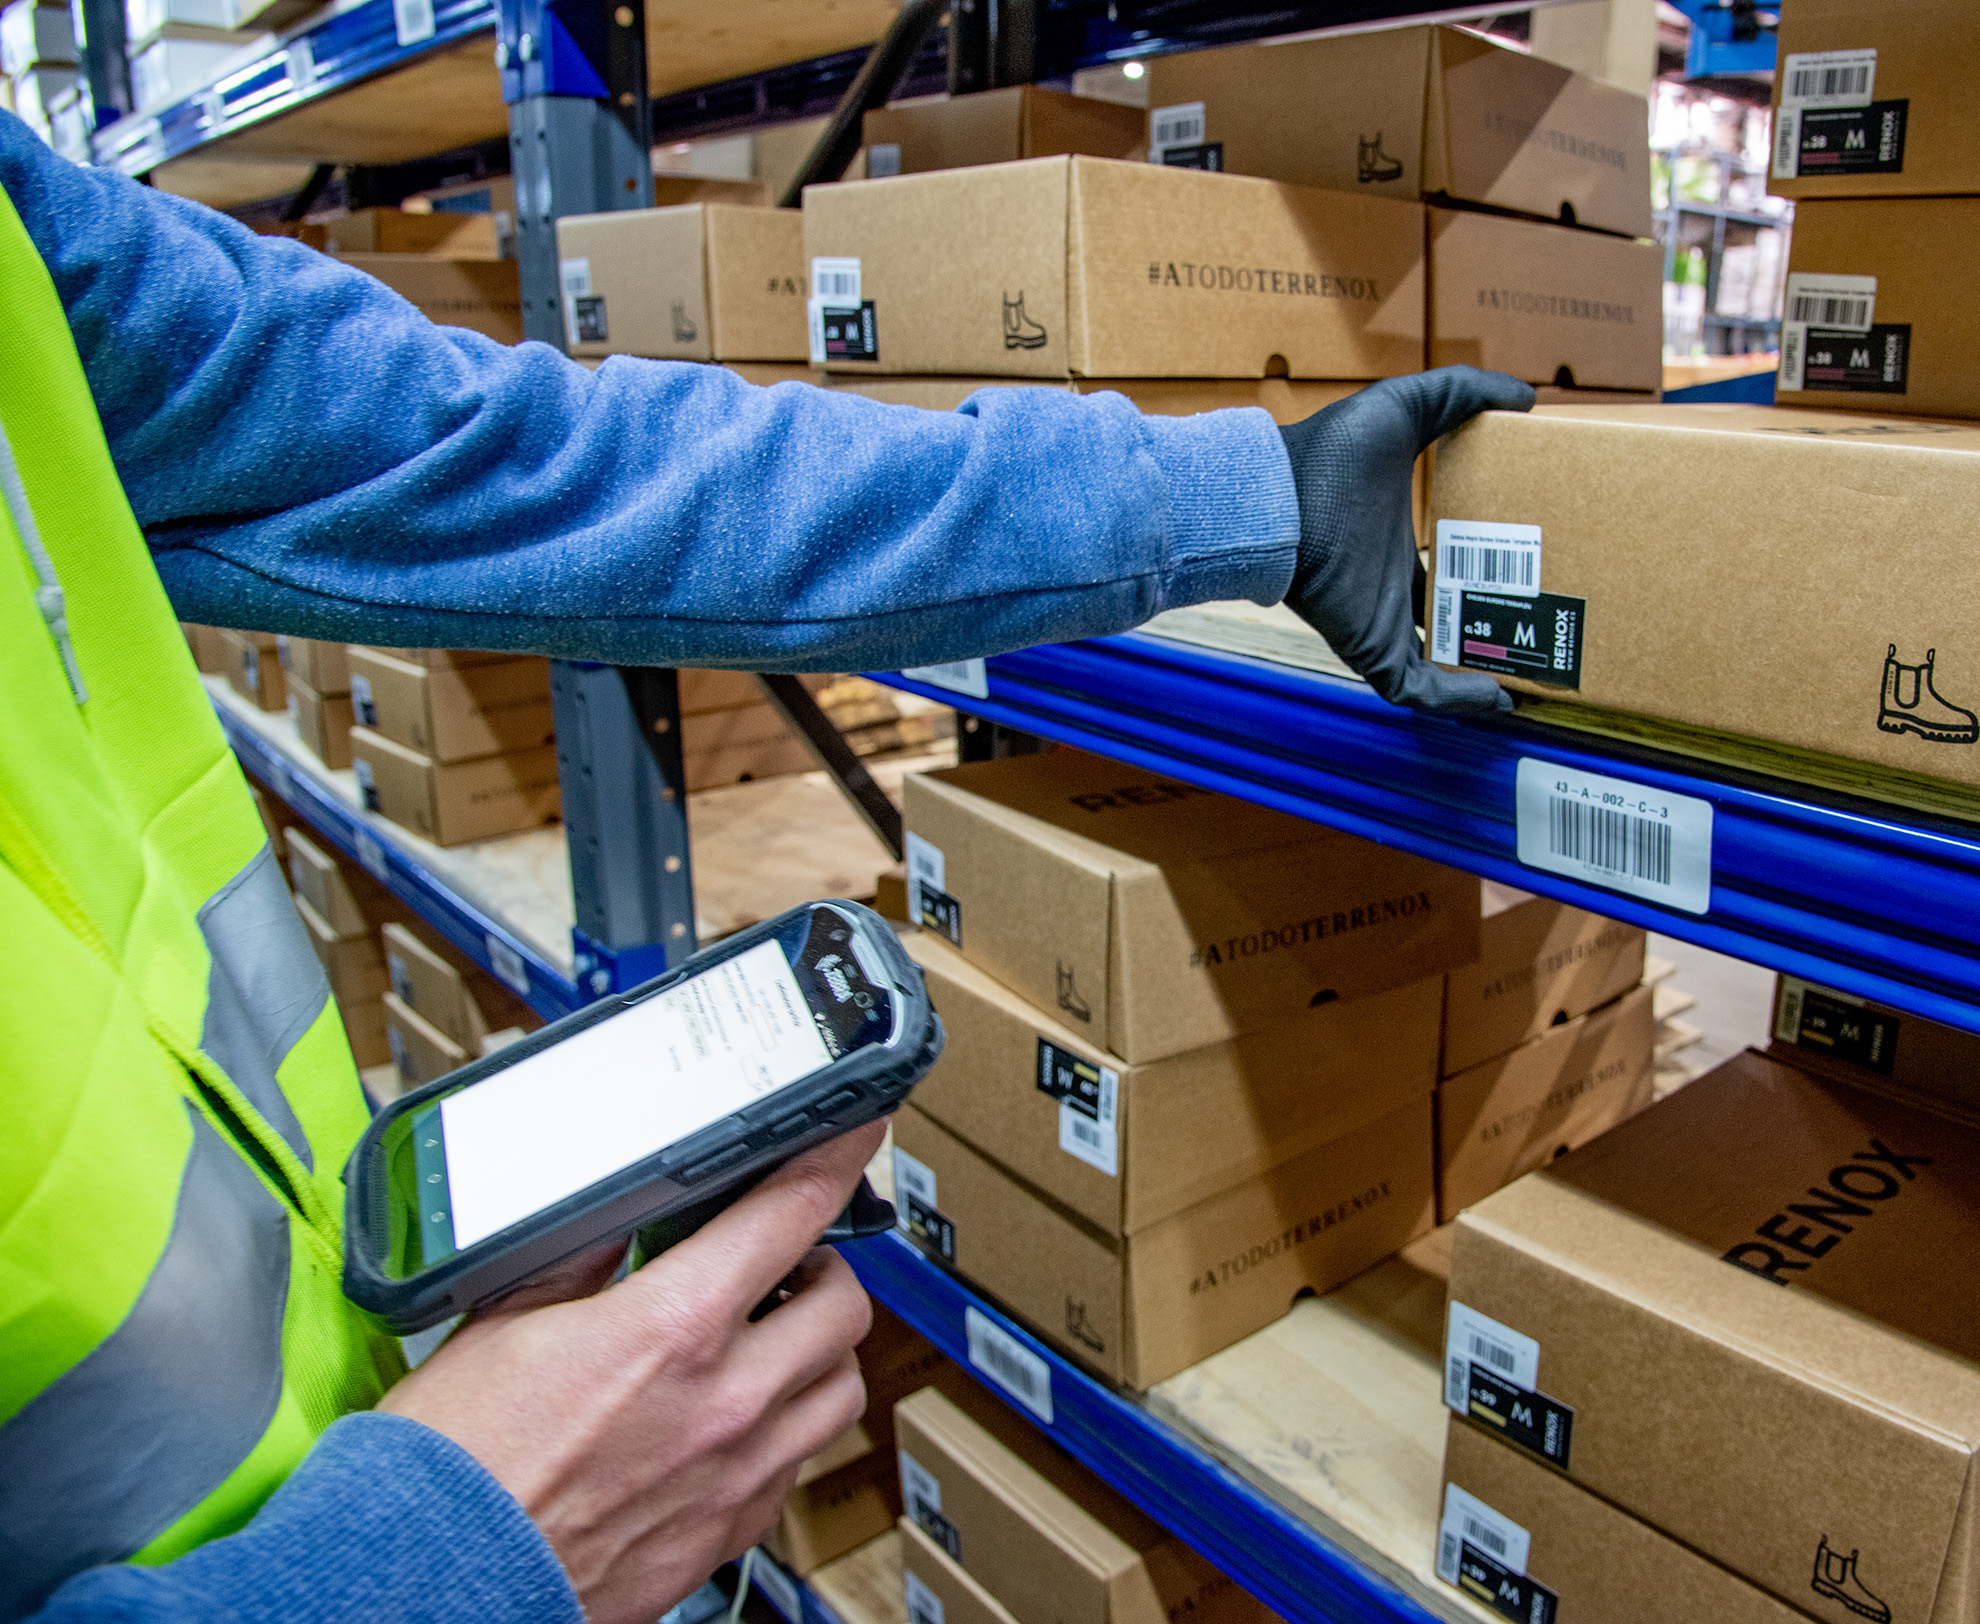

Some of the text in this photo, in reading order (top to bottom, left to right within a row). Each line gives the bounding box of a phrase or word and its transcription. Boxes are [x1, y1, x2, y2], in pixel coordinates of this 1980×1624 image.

[1845, 128, 1866, 149] M
[1148, 261, 1382, 301] #ATODOTERRENOX
[1850, 348, 1870, 368] M
[1473, 620, 1492, 637] 38
[1513, 621, 1536, 649] M
[1553, 608, 1569, 671] RENOX
[1720, 1139, 1934, 1288] RENOX
[1511, 1401, 1533, 1429] M
[1499, 1580, 1520, 1606] M
